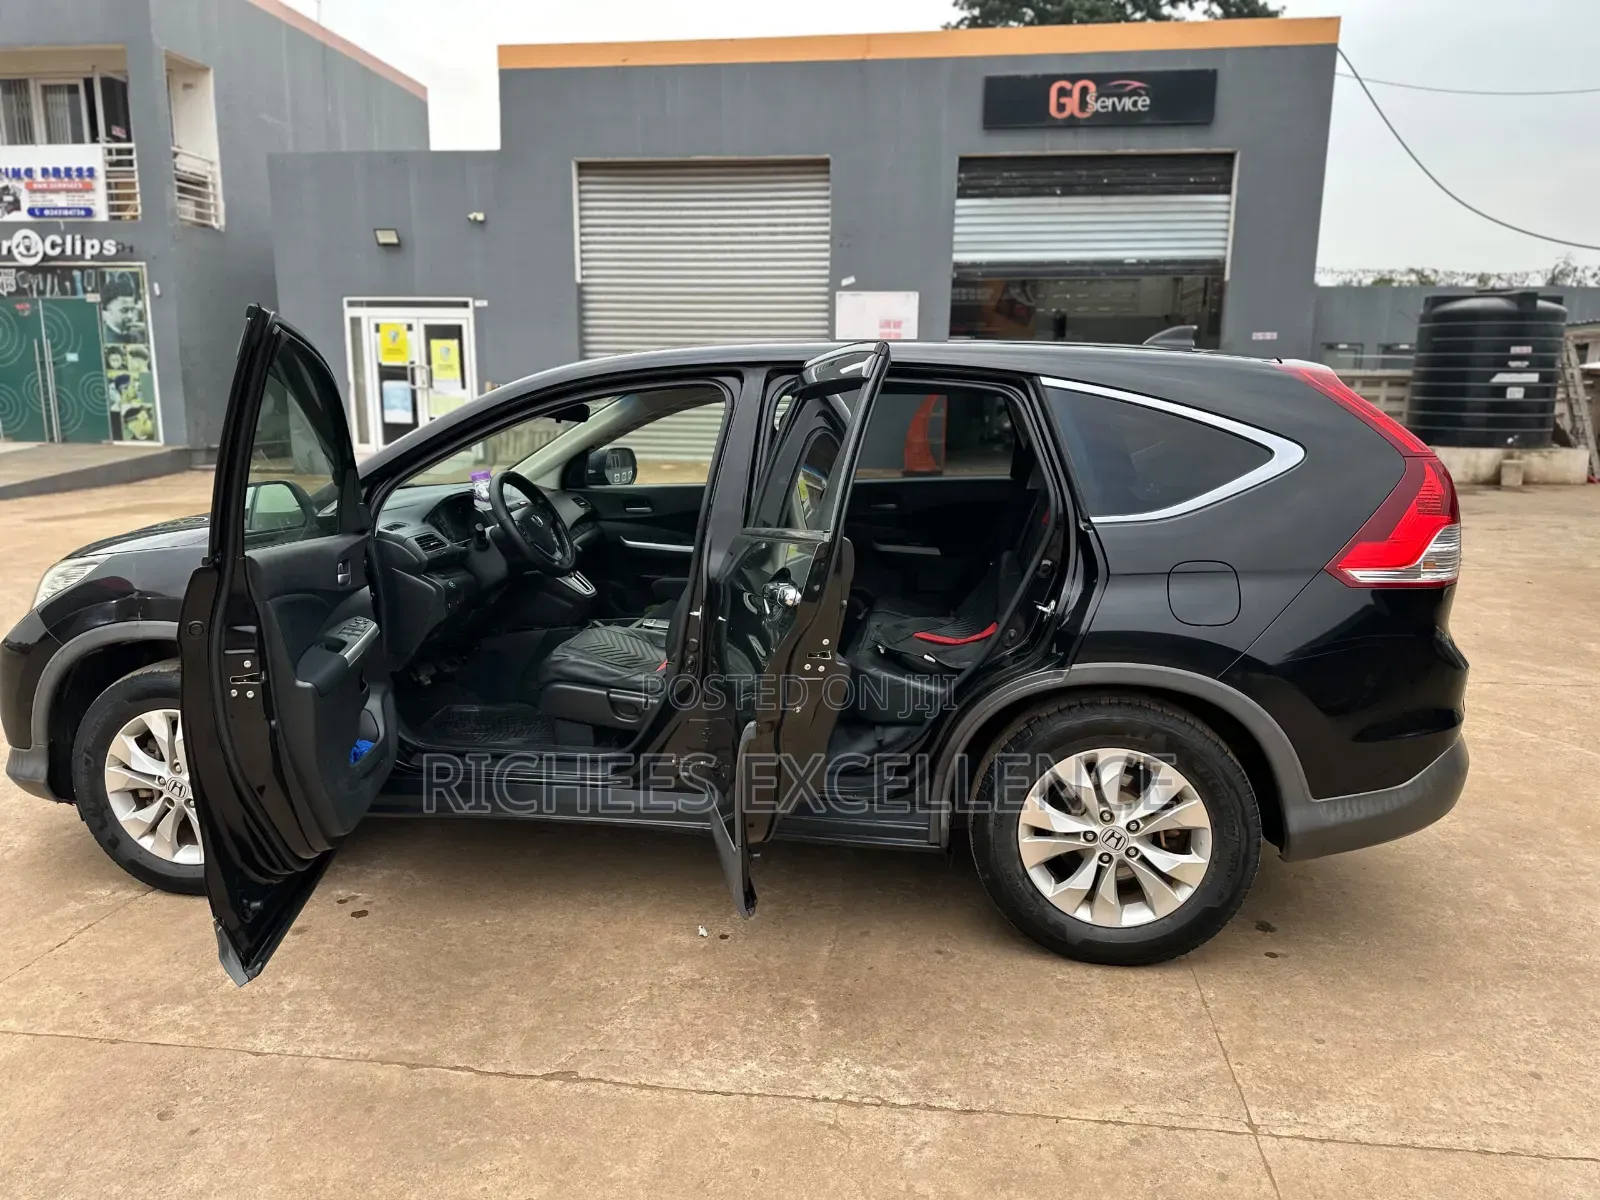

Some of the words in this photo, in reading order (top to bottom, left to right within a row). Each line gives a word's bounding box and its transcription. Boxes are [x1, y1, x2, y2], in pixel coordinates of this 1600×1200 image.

[1049, 79, 1097, 119] GO
[1086, 92, 1150, 113] Service
[0, 167, 34, 180] ING
[41, 166, 95, 180] PRESS
[45, 234, 117, 259] Clips
